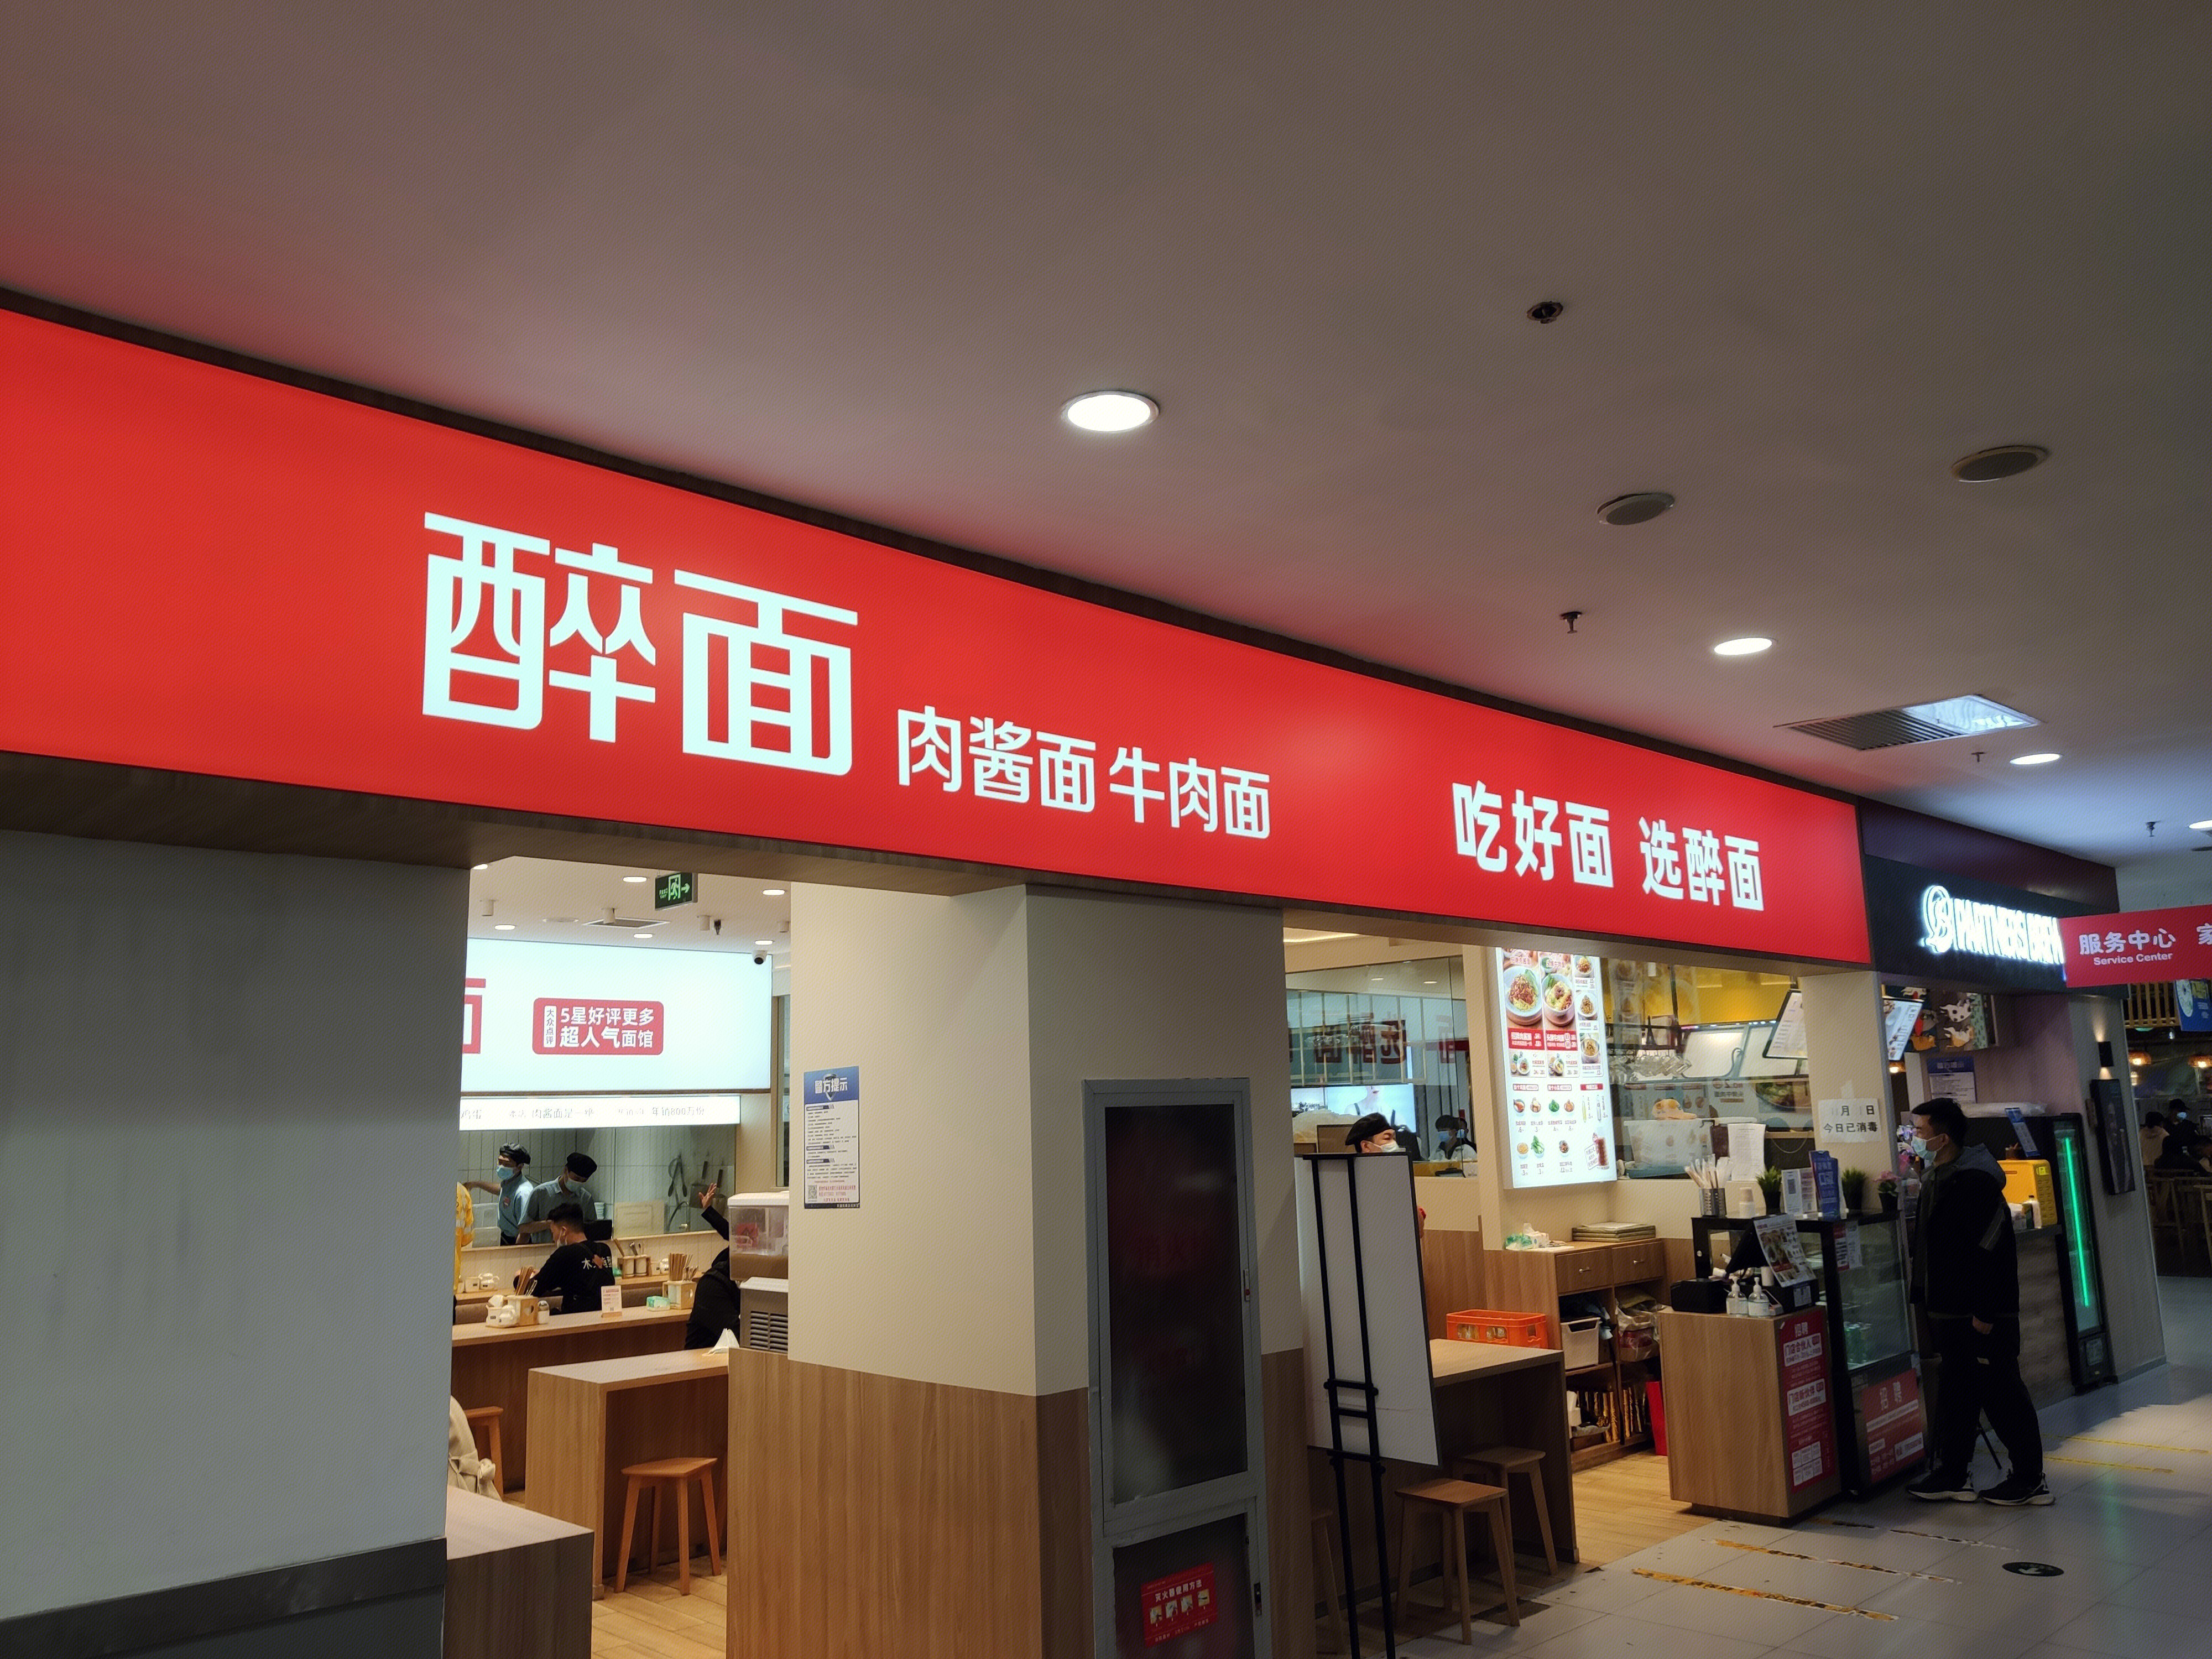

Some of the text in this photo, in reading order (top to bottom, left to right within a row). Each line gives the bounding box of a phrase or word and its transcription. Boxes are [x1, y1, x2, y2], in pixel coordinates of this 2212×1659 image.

[422, 512, 858, 776] 醉面
[897, 705, 1270, 839] 肉酱面 牛肉面
[1452, 780, 1764, 911] 吃好面 选醉面
[2079, 928, 2177, 955] 服务中心
[2094, 952, 2173, 966] Service Center
[545, 1008, 554, 1045] 大众点评
[560, 1006, 654, 1026] 5星好评更多
[559, 1026, 654, 1048] 超人气面馆
[815, 1077, 848, 1094] 警方提示
